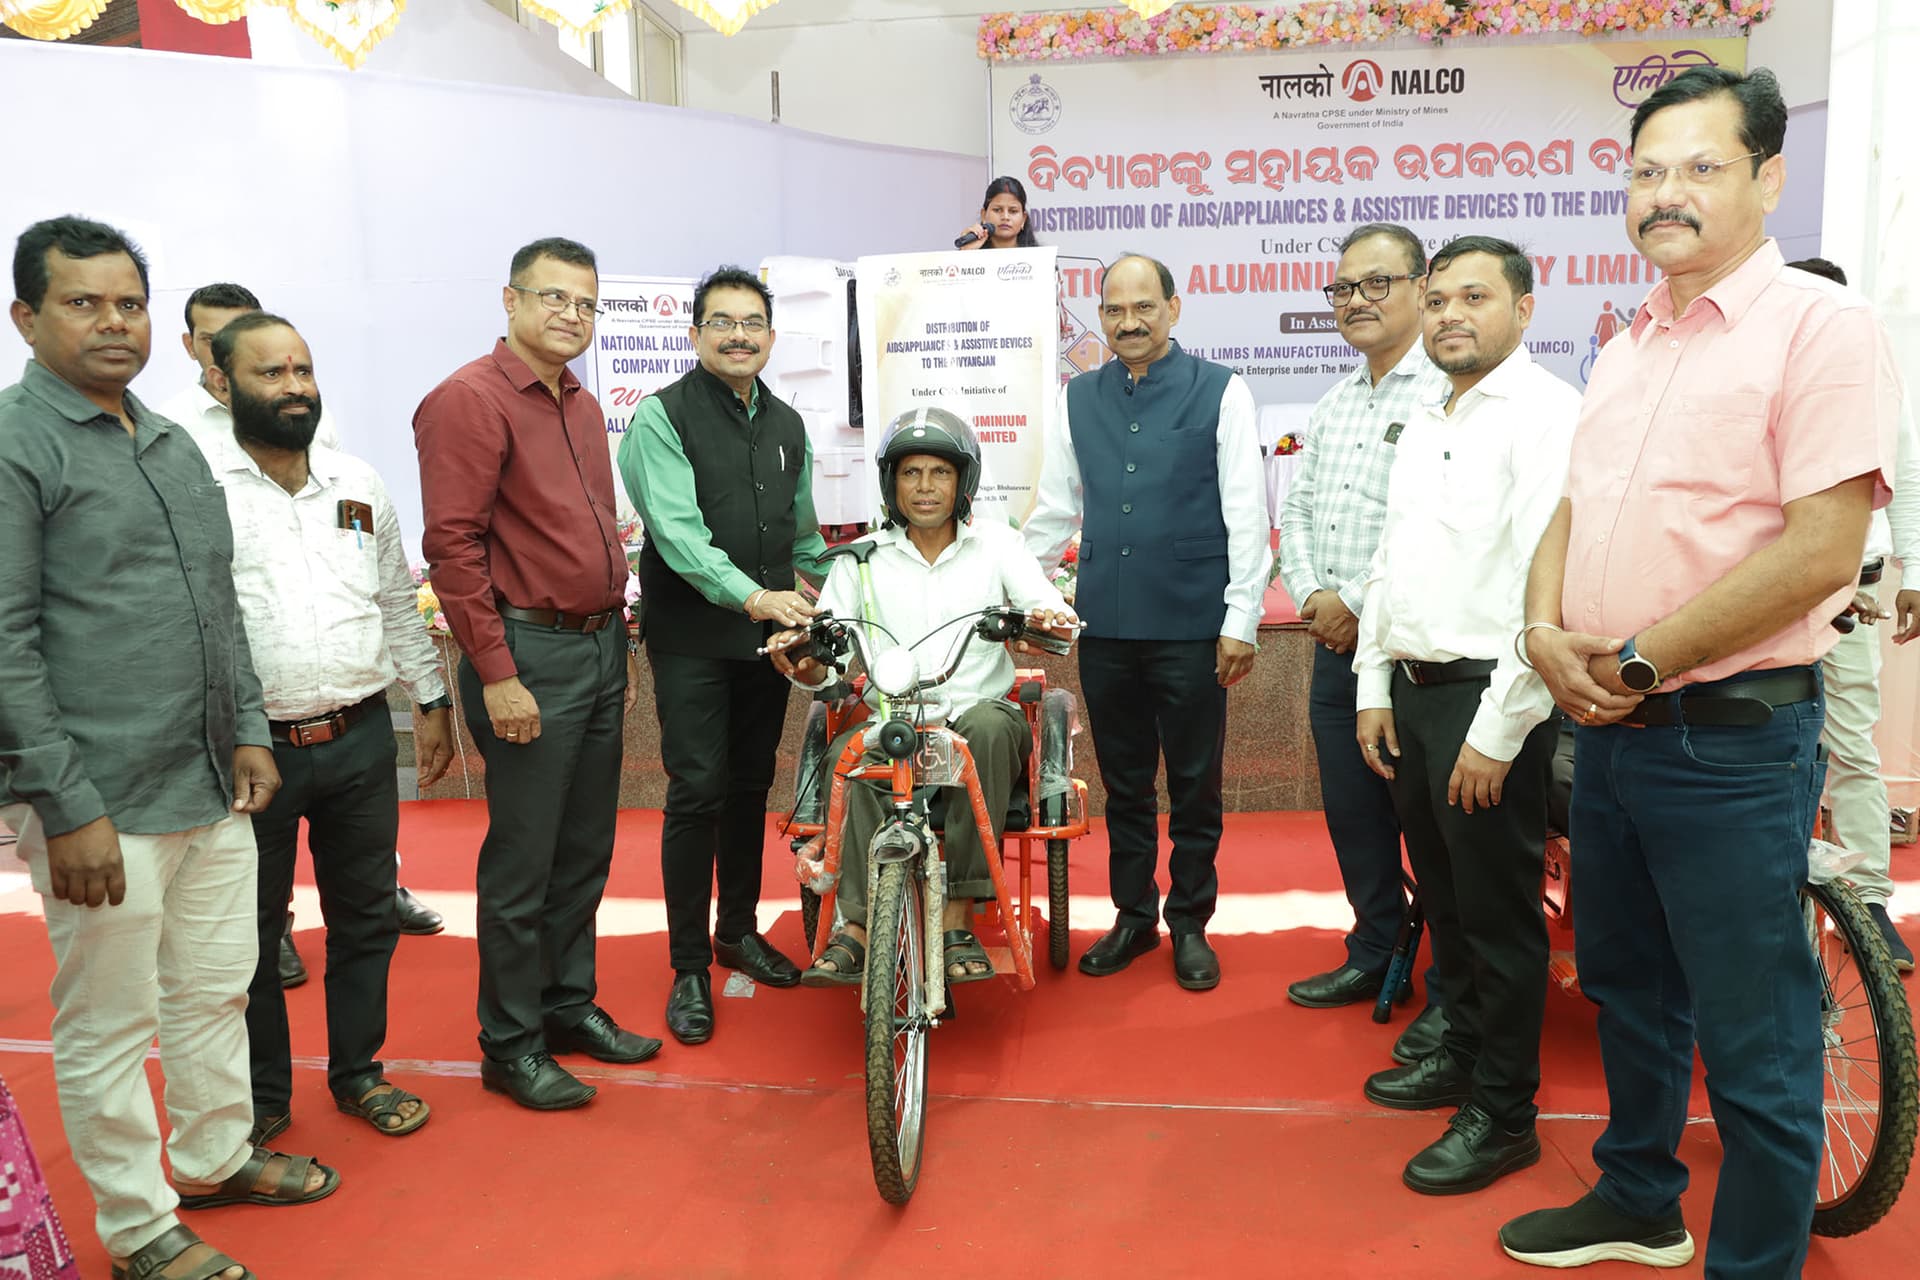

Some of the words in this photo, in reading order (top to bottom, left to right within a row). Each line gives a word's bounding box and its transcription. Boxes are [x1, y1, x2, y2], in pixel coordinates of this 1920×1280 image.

[1259, 64, 1334, 99] नालको
[1391, 68, 1465, 95] NALCO
[1273, 111, 1280, 120] A
[1282, 110, 1320, 120] Navratna
[1322, 109, 1345, 118] CPSE
[1348, 109, 1373, 117] under
[1376, 107, 1410, 117] Ministry
[1412, 107, 1421, 115] of
[1423, 106, 1448, 115] Mines
[1317, 121, 1369, 130] Government
[1372, 120, 1381, 128] of
[1382, 119, 1404, 128] India
[1031, 204, 1146, 232] DISTRIBUTION
[1152, 203, 1173, 229] OF
[1178, 199, 1328, 229] AIDS/APPLIANCES
[1333, 198, 1346, 222] &
[1351, 194, 1439, 222] ASSISTIVE
[1444, 192, 1518, 220] DEVICES
[1524, 192, 1546, 218] TO
[1552, 190, 1585, 217] THE
[1261, 238, 1312, 254] Under
[1317, 237, 1345, 253] CS
[961, 267, 985, 275] NALCO
[1187, 261, 1337, 294] ALUMINI
[1567, 254, 1657, 285] LIMIT
[601, 296, 648, 312] नालको
[980, 320, 990, 331] OF
[1290, 317, 1305, 330] In
[601, 336, 658, 351] NATIONAL
[961, 338, 998, 350] ASSISTIVE
[1000, 337, 1033, 349] DEVICES
[1212, 347, 1249, 360] LIMBS
[1524, 341, 1575, 355] LIMCO)
[613, 358, 670, 374] COMPANY
[922, 357, 931, 369] TO
[1247, 365, 1290, 376] Enterprise
[1293, 366, 1318, 375] under
[1321, 364, 1337, 374] The
[912, 388, 936, 396] Under
[998, 385, 1007, 394] of
[972, 415, 1027, 427] UMINIUM
